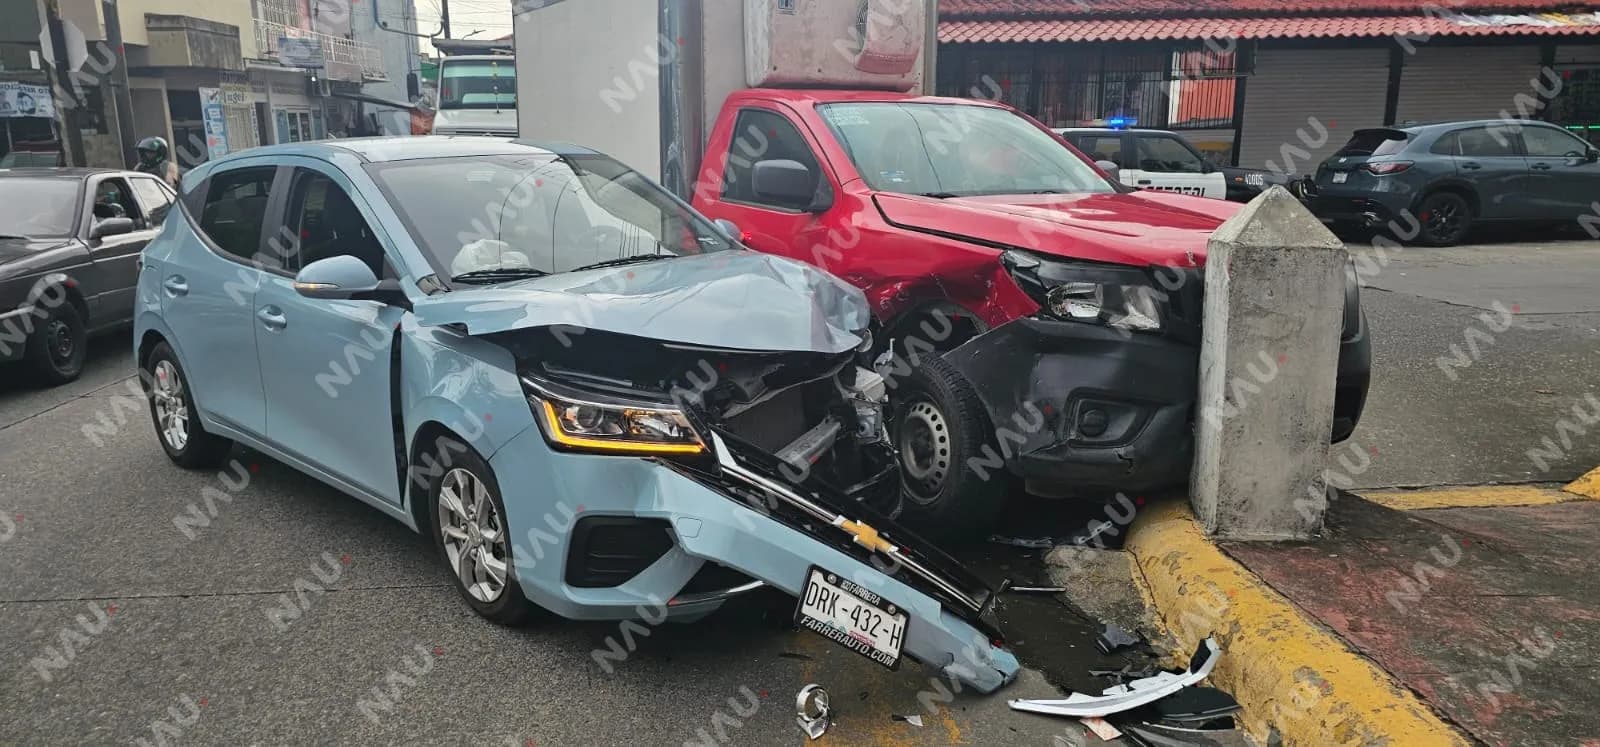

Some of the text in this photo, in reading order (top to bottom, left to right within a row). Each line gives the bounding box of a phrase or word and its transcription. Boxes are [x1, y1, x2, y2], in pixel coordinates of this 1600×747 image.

[805, 581, 902, 650] DRK-432-H
[849, 584, 881, 606] FARRERA
[800, 615, 896, 667] FARRERAUTO.COM
